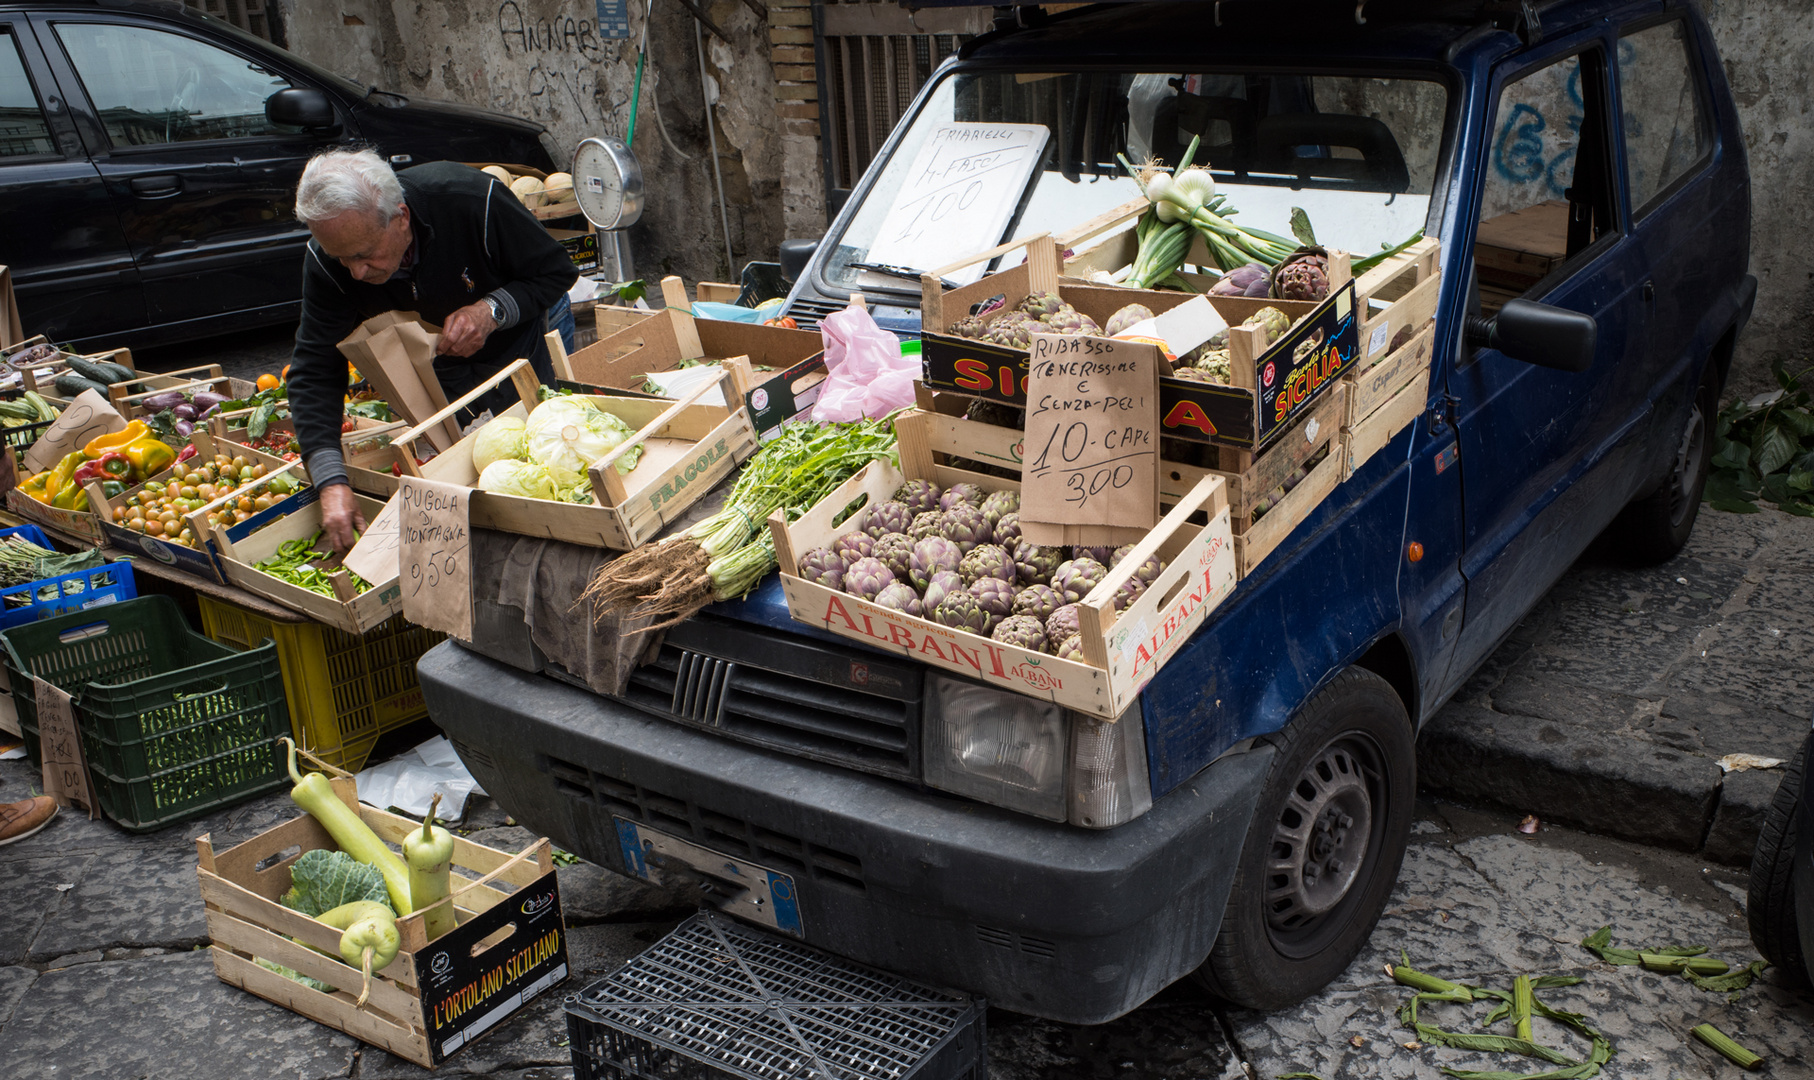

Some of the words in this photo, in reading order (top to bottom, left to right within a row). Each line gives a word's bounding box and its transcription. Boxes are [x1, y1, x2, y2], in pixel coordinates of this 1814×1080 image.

[932, 127, 1013, 147] FRIARIELLI
[1034, 338, 1114, 359] RIBASSO
[1076, 380, 1090, 393] E
[1275, 346, 1342, 422] SICILIA
[648, 438, 729, 512] FRAGOLE
[1065, 465, 1133, 509] 3,00
[403, 484, 458, 513] RUGOLA
[404, 524, 466, 545] MONTAGNA
[418, 510, 433, 526] DI
[856, 602, 903, 623] azienda
[904, 619, 957, 640] agricola
[1131, 566, 1214, 679] ALBANI
[821, 595, 1012, 681] ALBANI
[1010, 664, 1064, 690] ALBANI
[434, 964, 503, 1031] L'ORTOLANO
[505, 928, 559, 986] SICILIANO
